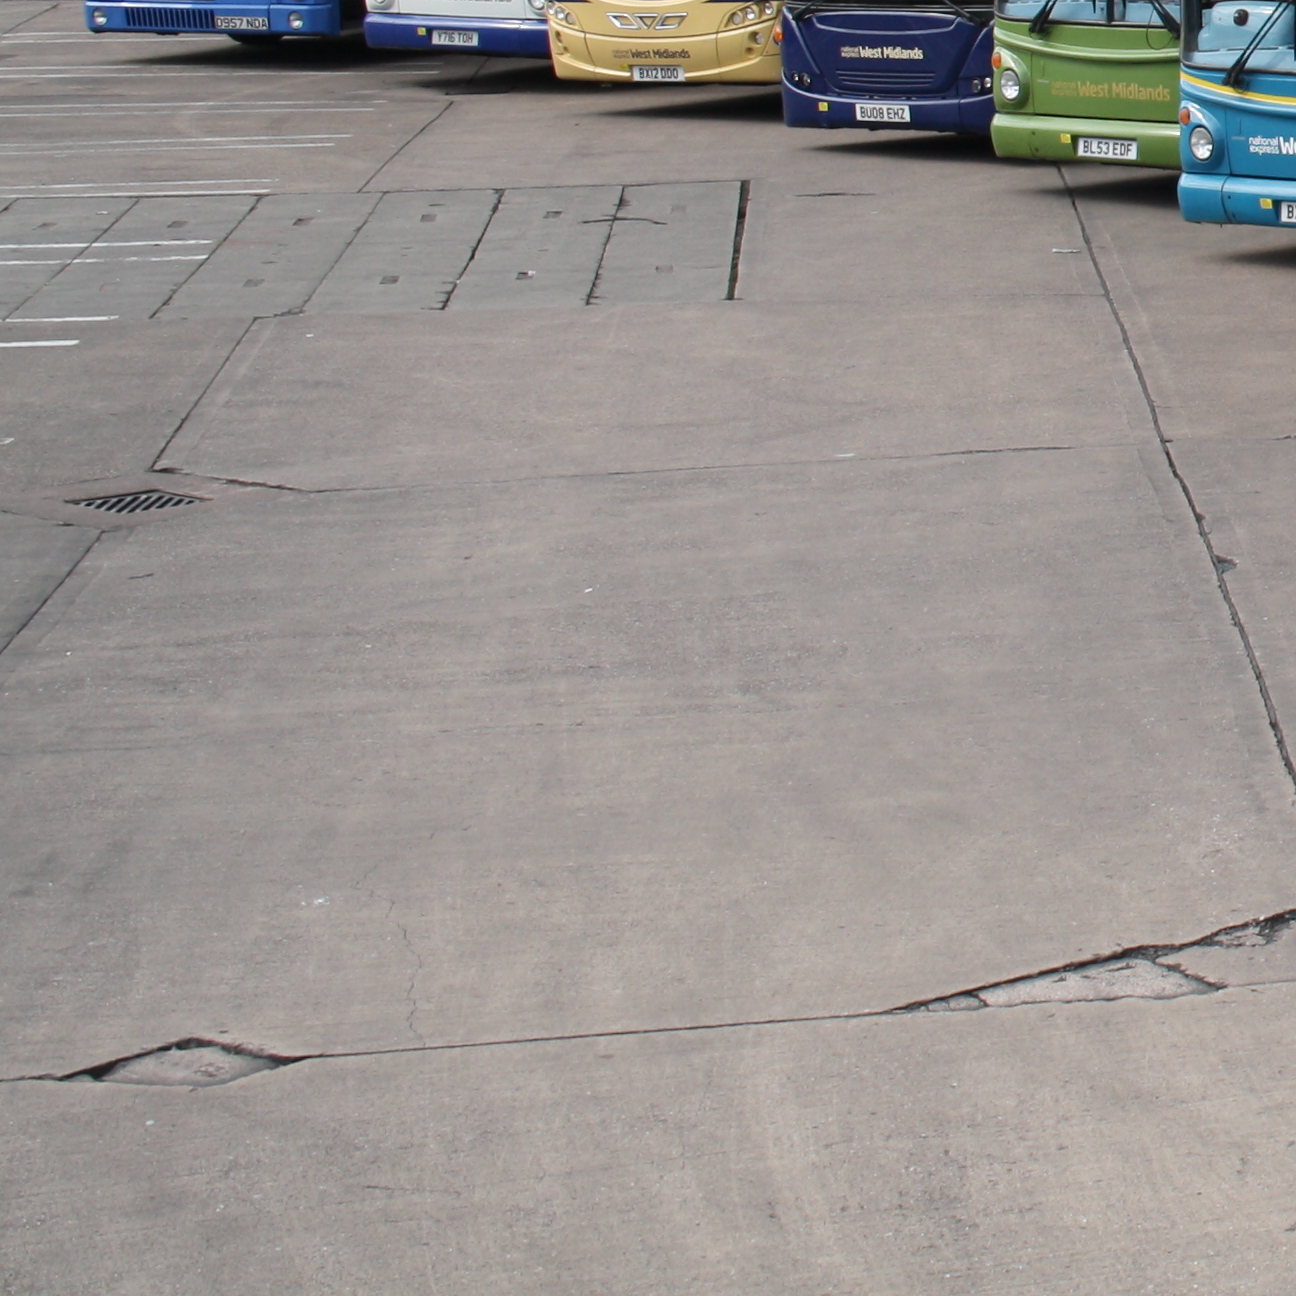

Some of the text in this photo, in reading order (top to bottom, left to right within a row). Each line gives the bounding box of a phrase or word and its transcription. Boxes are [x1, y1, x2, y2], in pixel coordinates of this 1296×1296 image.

[216, 17, 243, 29] D957
[859, 46, 924, 59] West Midlands
[1077, 81, 1171, 101] West Midlands
[859, 106, 906, 120] BU08 EHZ
[1248, 135, 1279, 145] national
[1083, 140, 1133, 157] BL53 EDF
[1249, 145, 1279, 155] express
